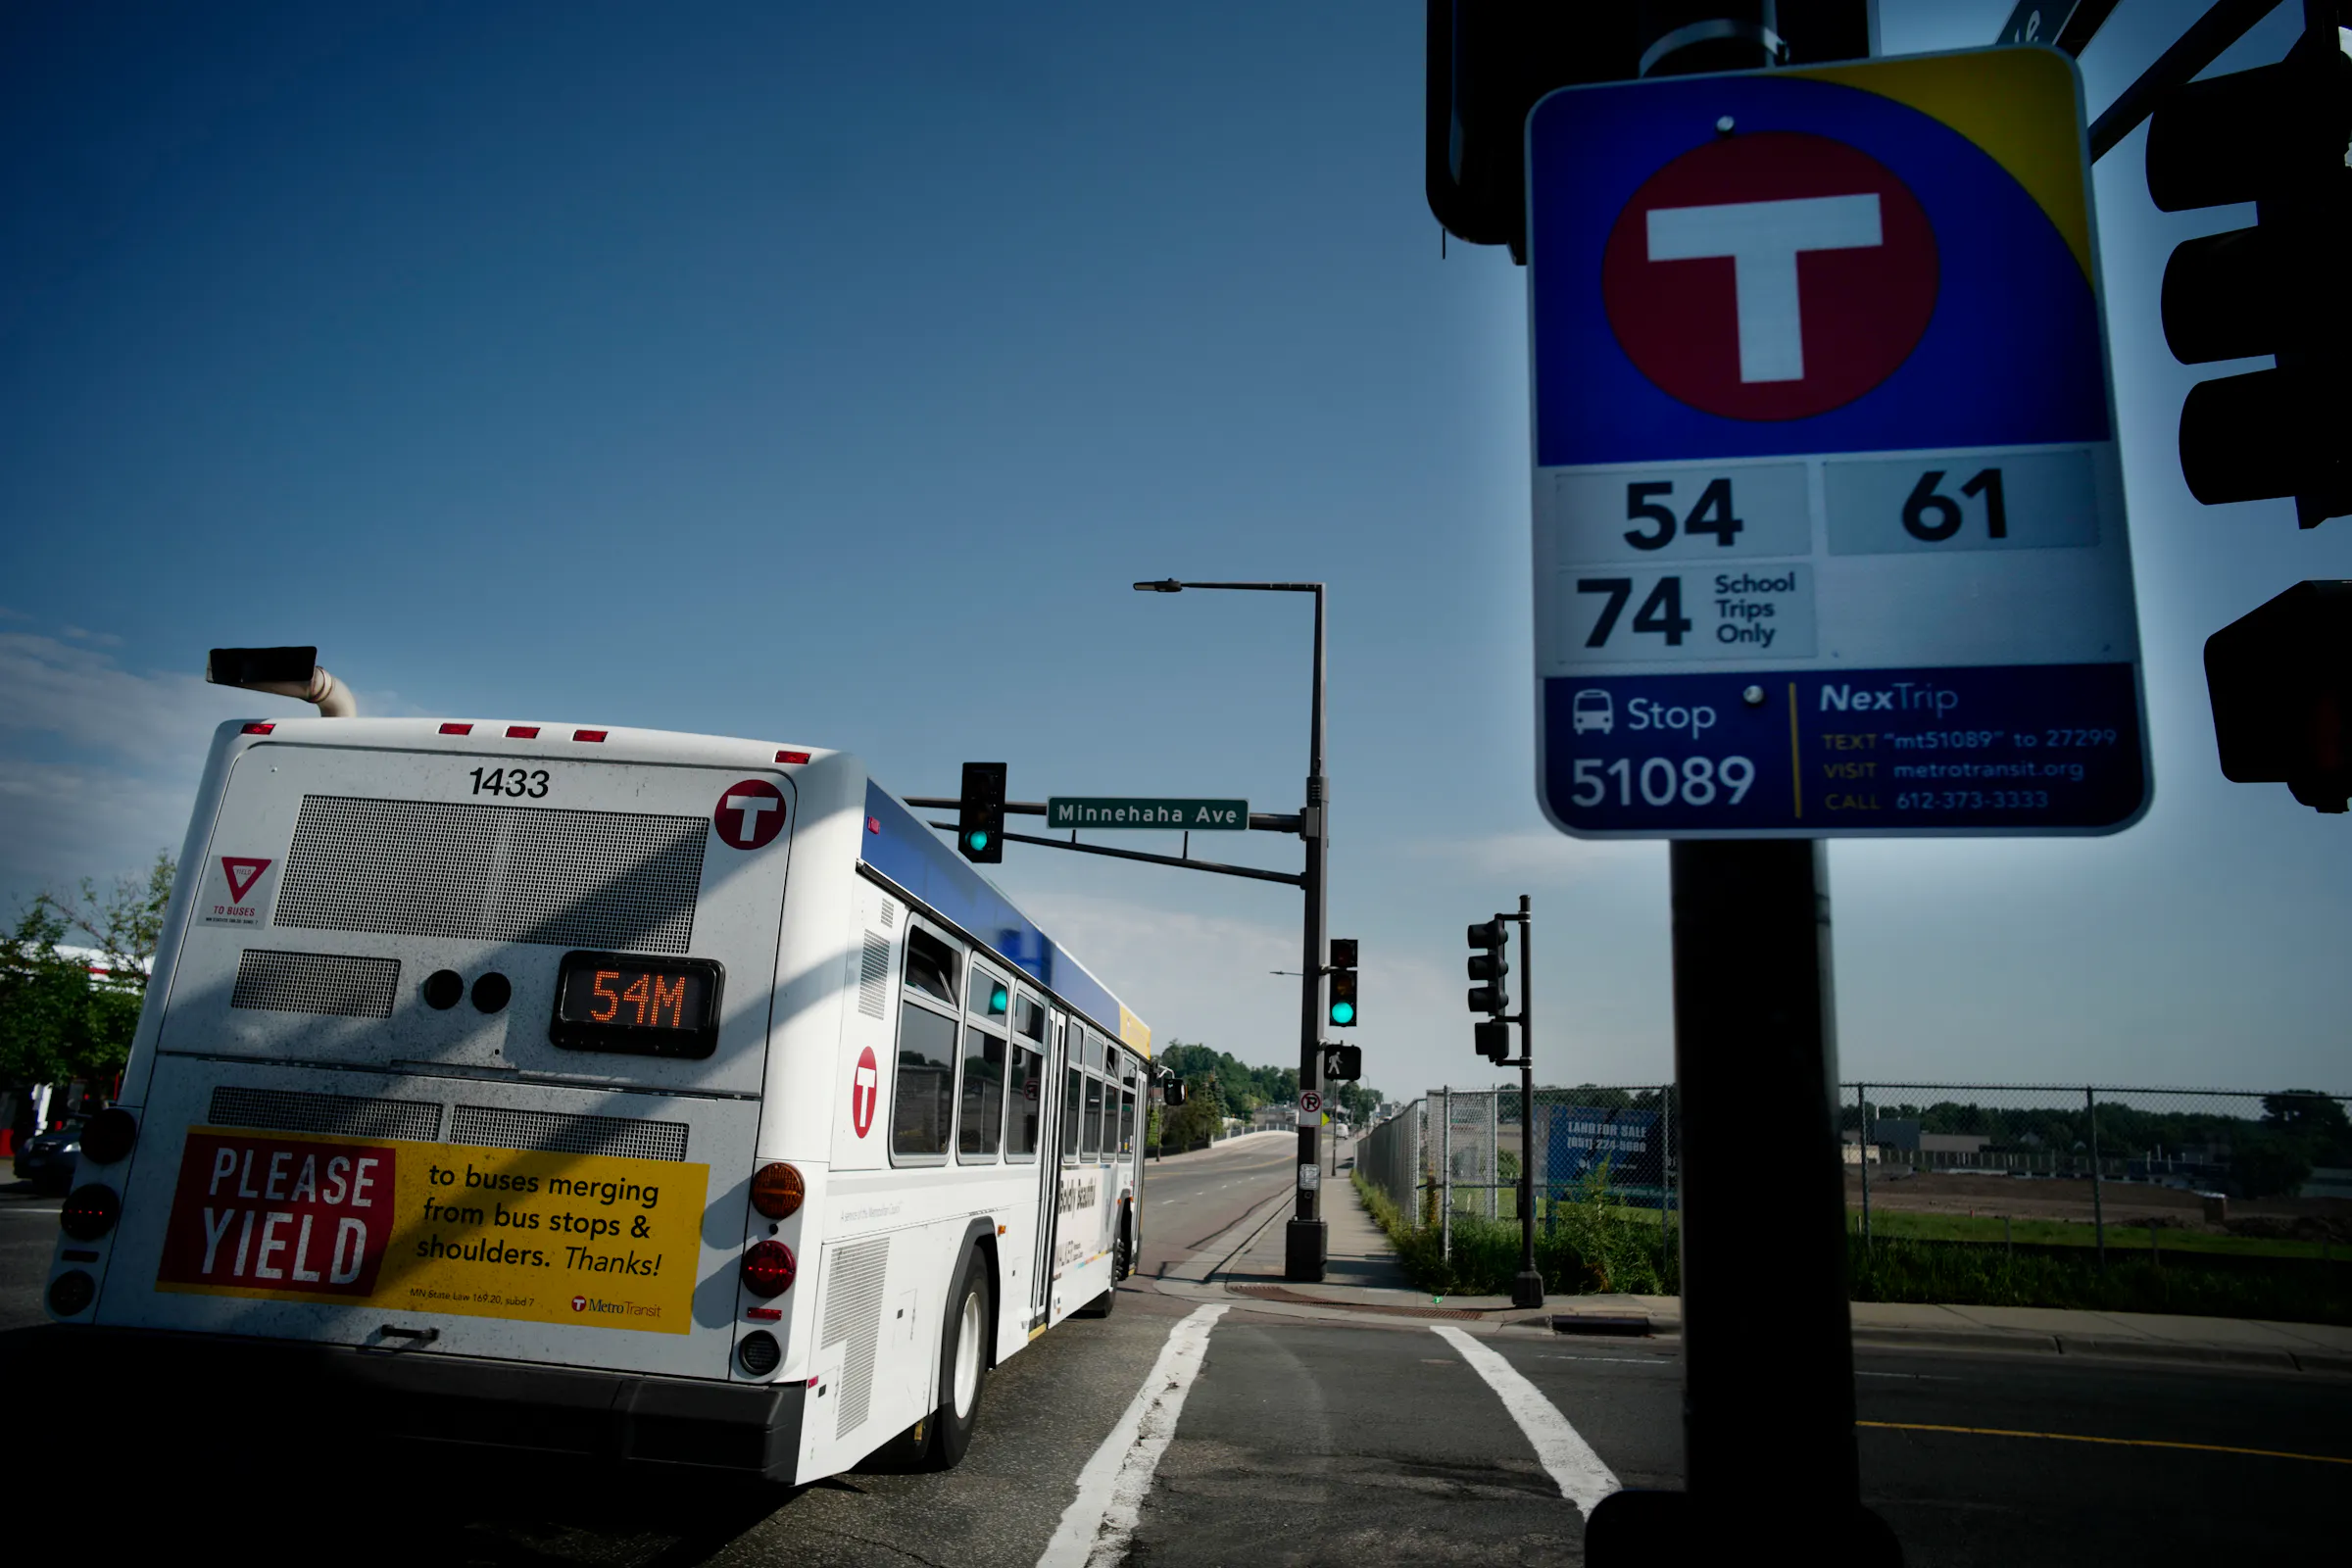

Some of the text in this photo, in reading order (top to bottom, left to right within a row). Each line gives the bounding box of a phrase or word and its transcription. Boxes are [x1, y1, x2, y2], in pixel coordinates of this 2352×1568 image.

[1624, 478, 1742, 551] 54
[1902, 468, 2008, 543] 61
[1715, 571, 1795, 594] School
[1577, 576, 1691, 649] 74
[1715, 599, 1775, 622] Trips
[1717, 622, 1775, 649] Only
[1627, 696, 1717, 741] Stop
[1819, 682, 1959, 719] NexTrip
[1821, 733, 1878, 751] TEXT
[2013, 733, 2038, 749] to
[2045, 728, 2117, 749] 27299
[469, 767, 550, 798] 1433
[1570, 755, 1757, 808] 51089
[1823, 760, 2084, 782] VISIT metrotransit.org
[1057, 804, 1237, 823] Minnehaha Ave
[1824, 790, 2049, 810] CALL 612-373-3333
[214, 906, 256, 916] TO BUSES
[590, 968, 686, 1028] 54M
[1568, 1121, 1647, 1139] LAND FOR SALE
[209, 1147, 379, 1208] PLEASE
[428, 1163, 660, 1209] to buses merging
[423, 1197, 651, 1241] from bus stops &
[201, 1206, 368, 1285] YIELD
[416, 1234, 662, 1277] shoulders. Thanks!
[410, 1288, 426, 1298] MN
[428, 1290, 451, 1299] State
[453, 1292, 469, 1301] Law
[506, 1297, 527, 1306] subd
[528, 1298, 535, 1306] 7
